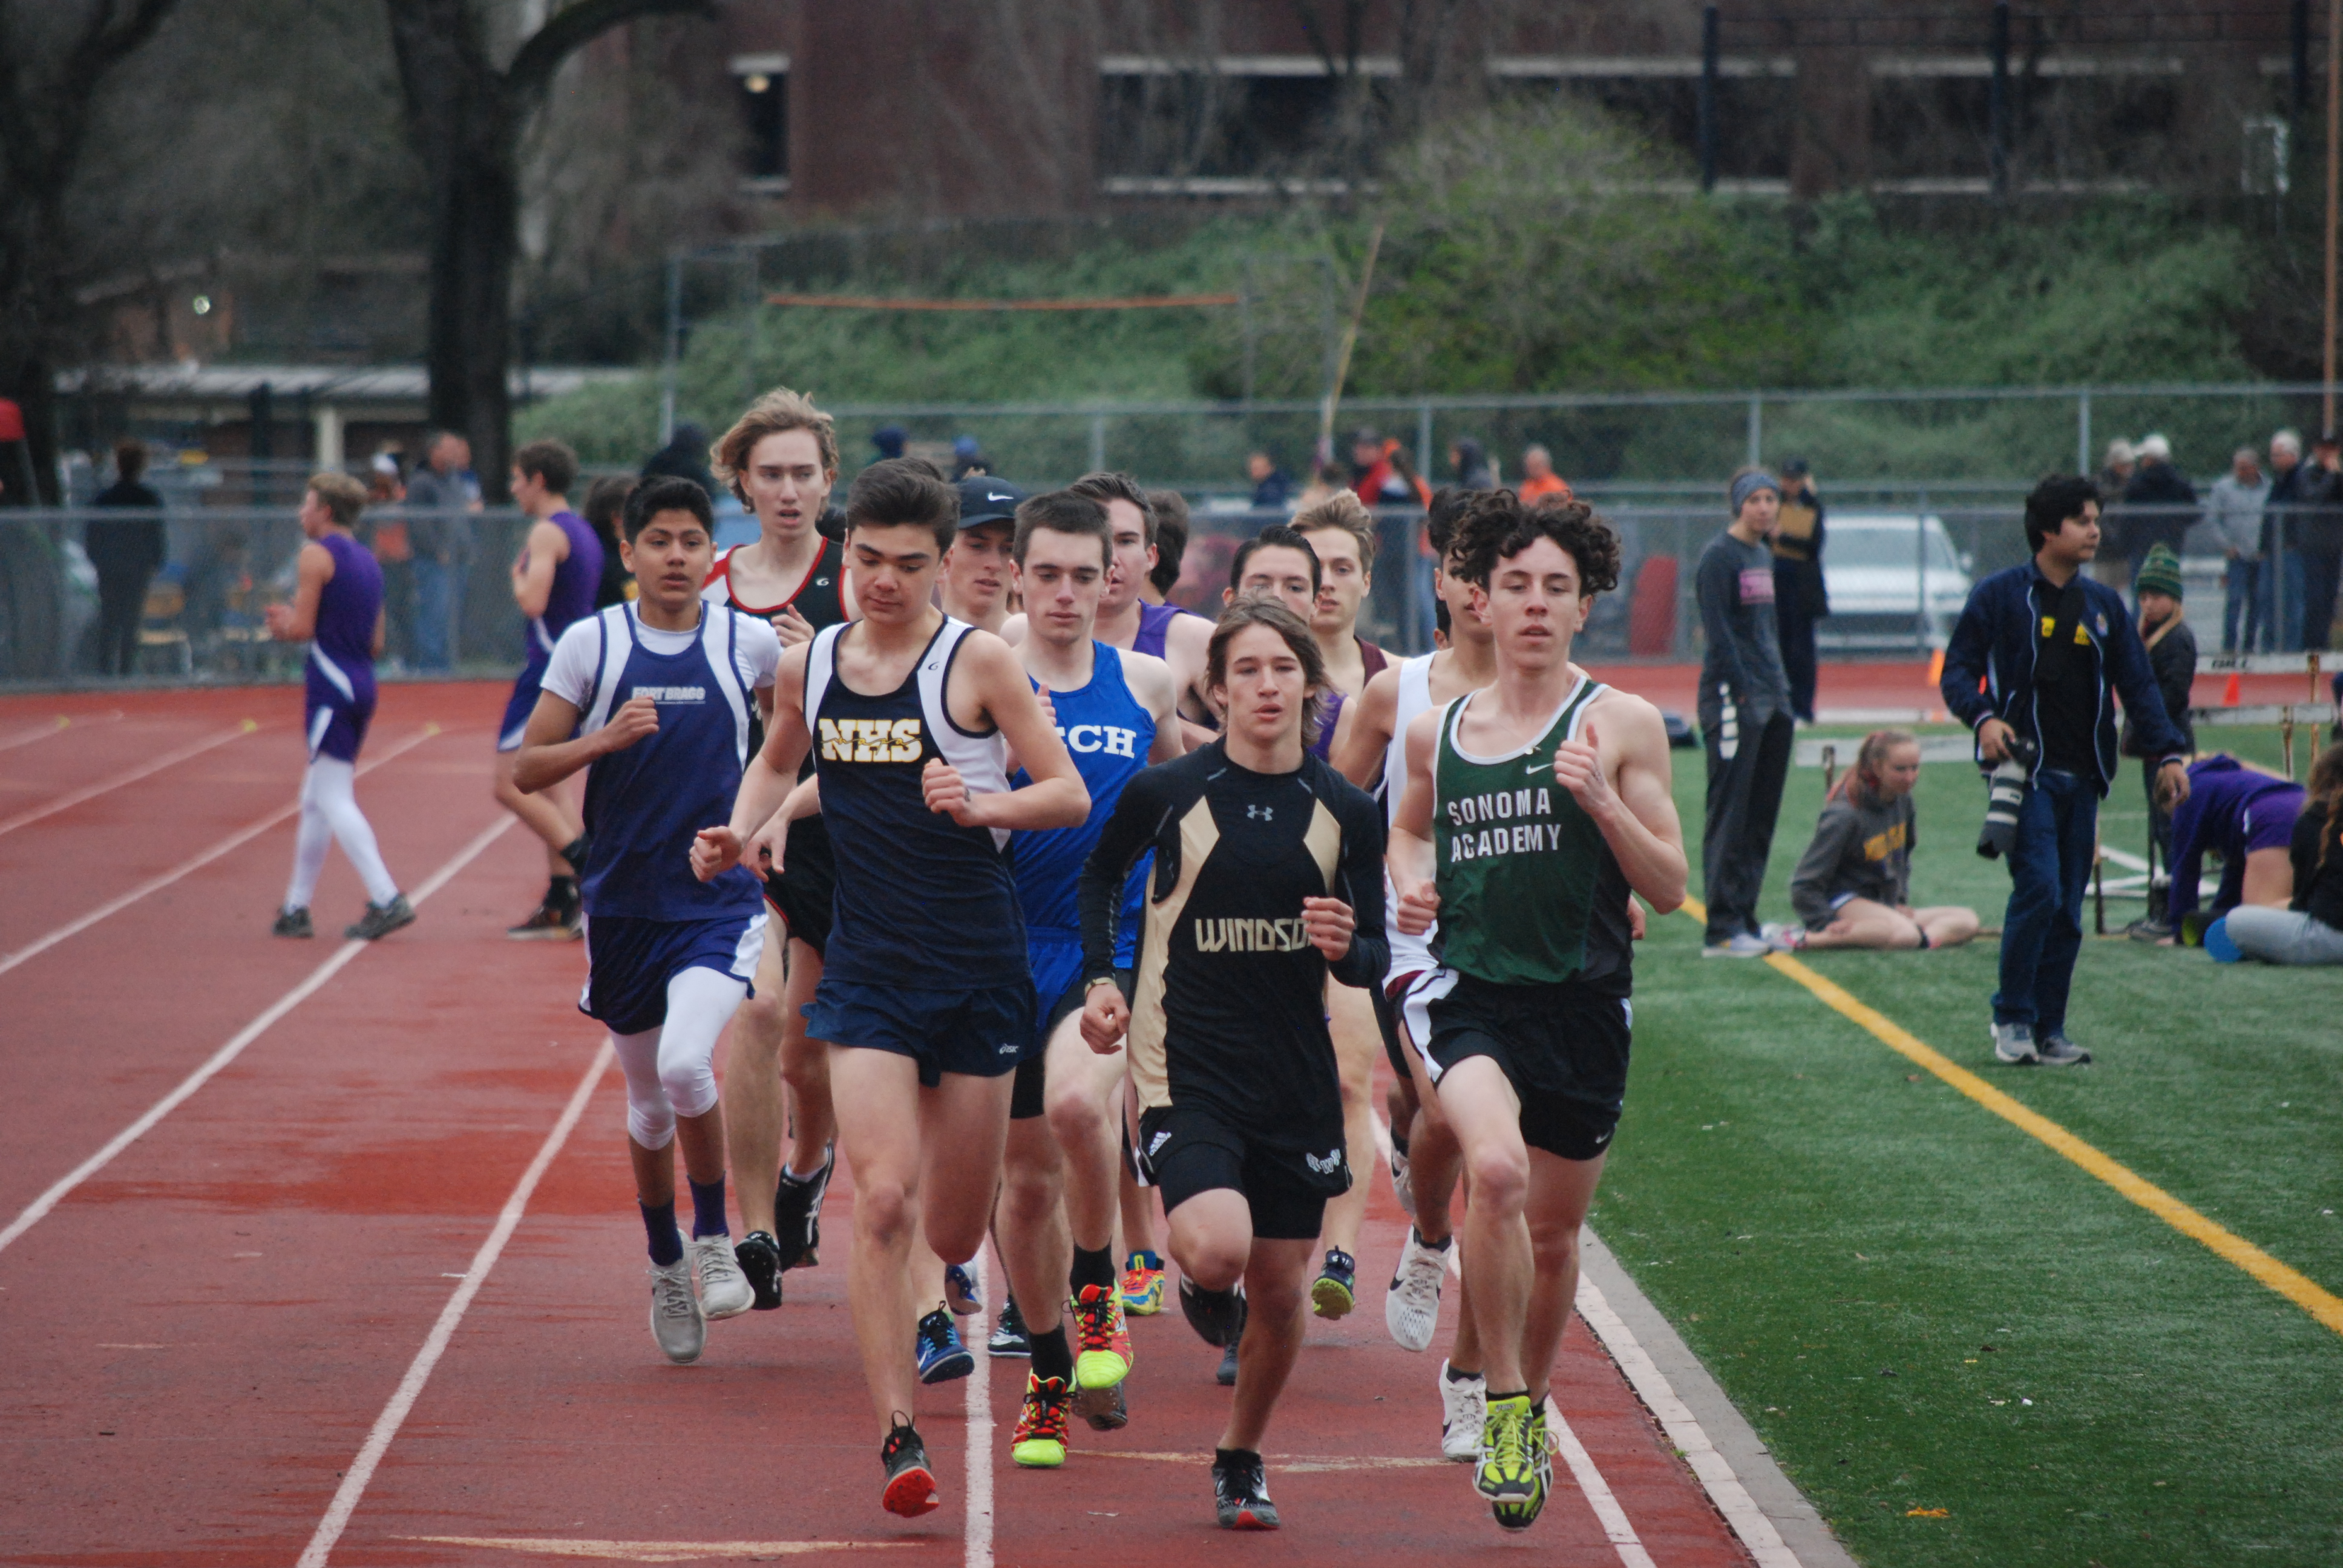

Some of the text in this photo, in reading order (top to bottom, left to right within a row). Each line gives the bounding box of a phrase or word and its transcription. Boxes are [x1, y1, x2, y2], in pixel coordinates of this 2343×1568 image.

[632, 687, 706, 701] FORT BRAGG
[819, 718, 923, 763] NHS
[1055, 724, 1137, 759] CH
[1447, 788, 1552, 826] SONOMA
[1450, 823, 1562, 863] ACADEMY
[1194, 918, 1312, 952] WINDSO
